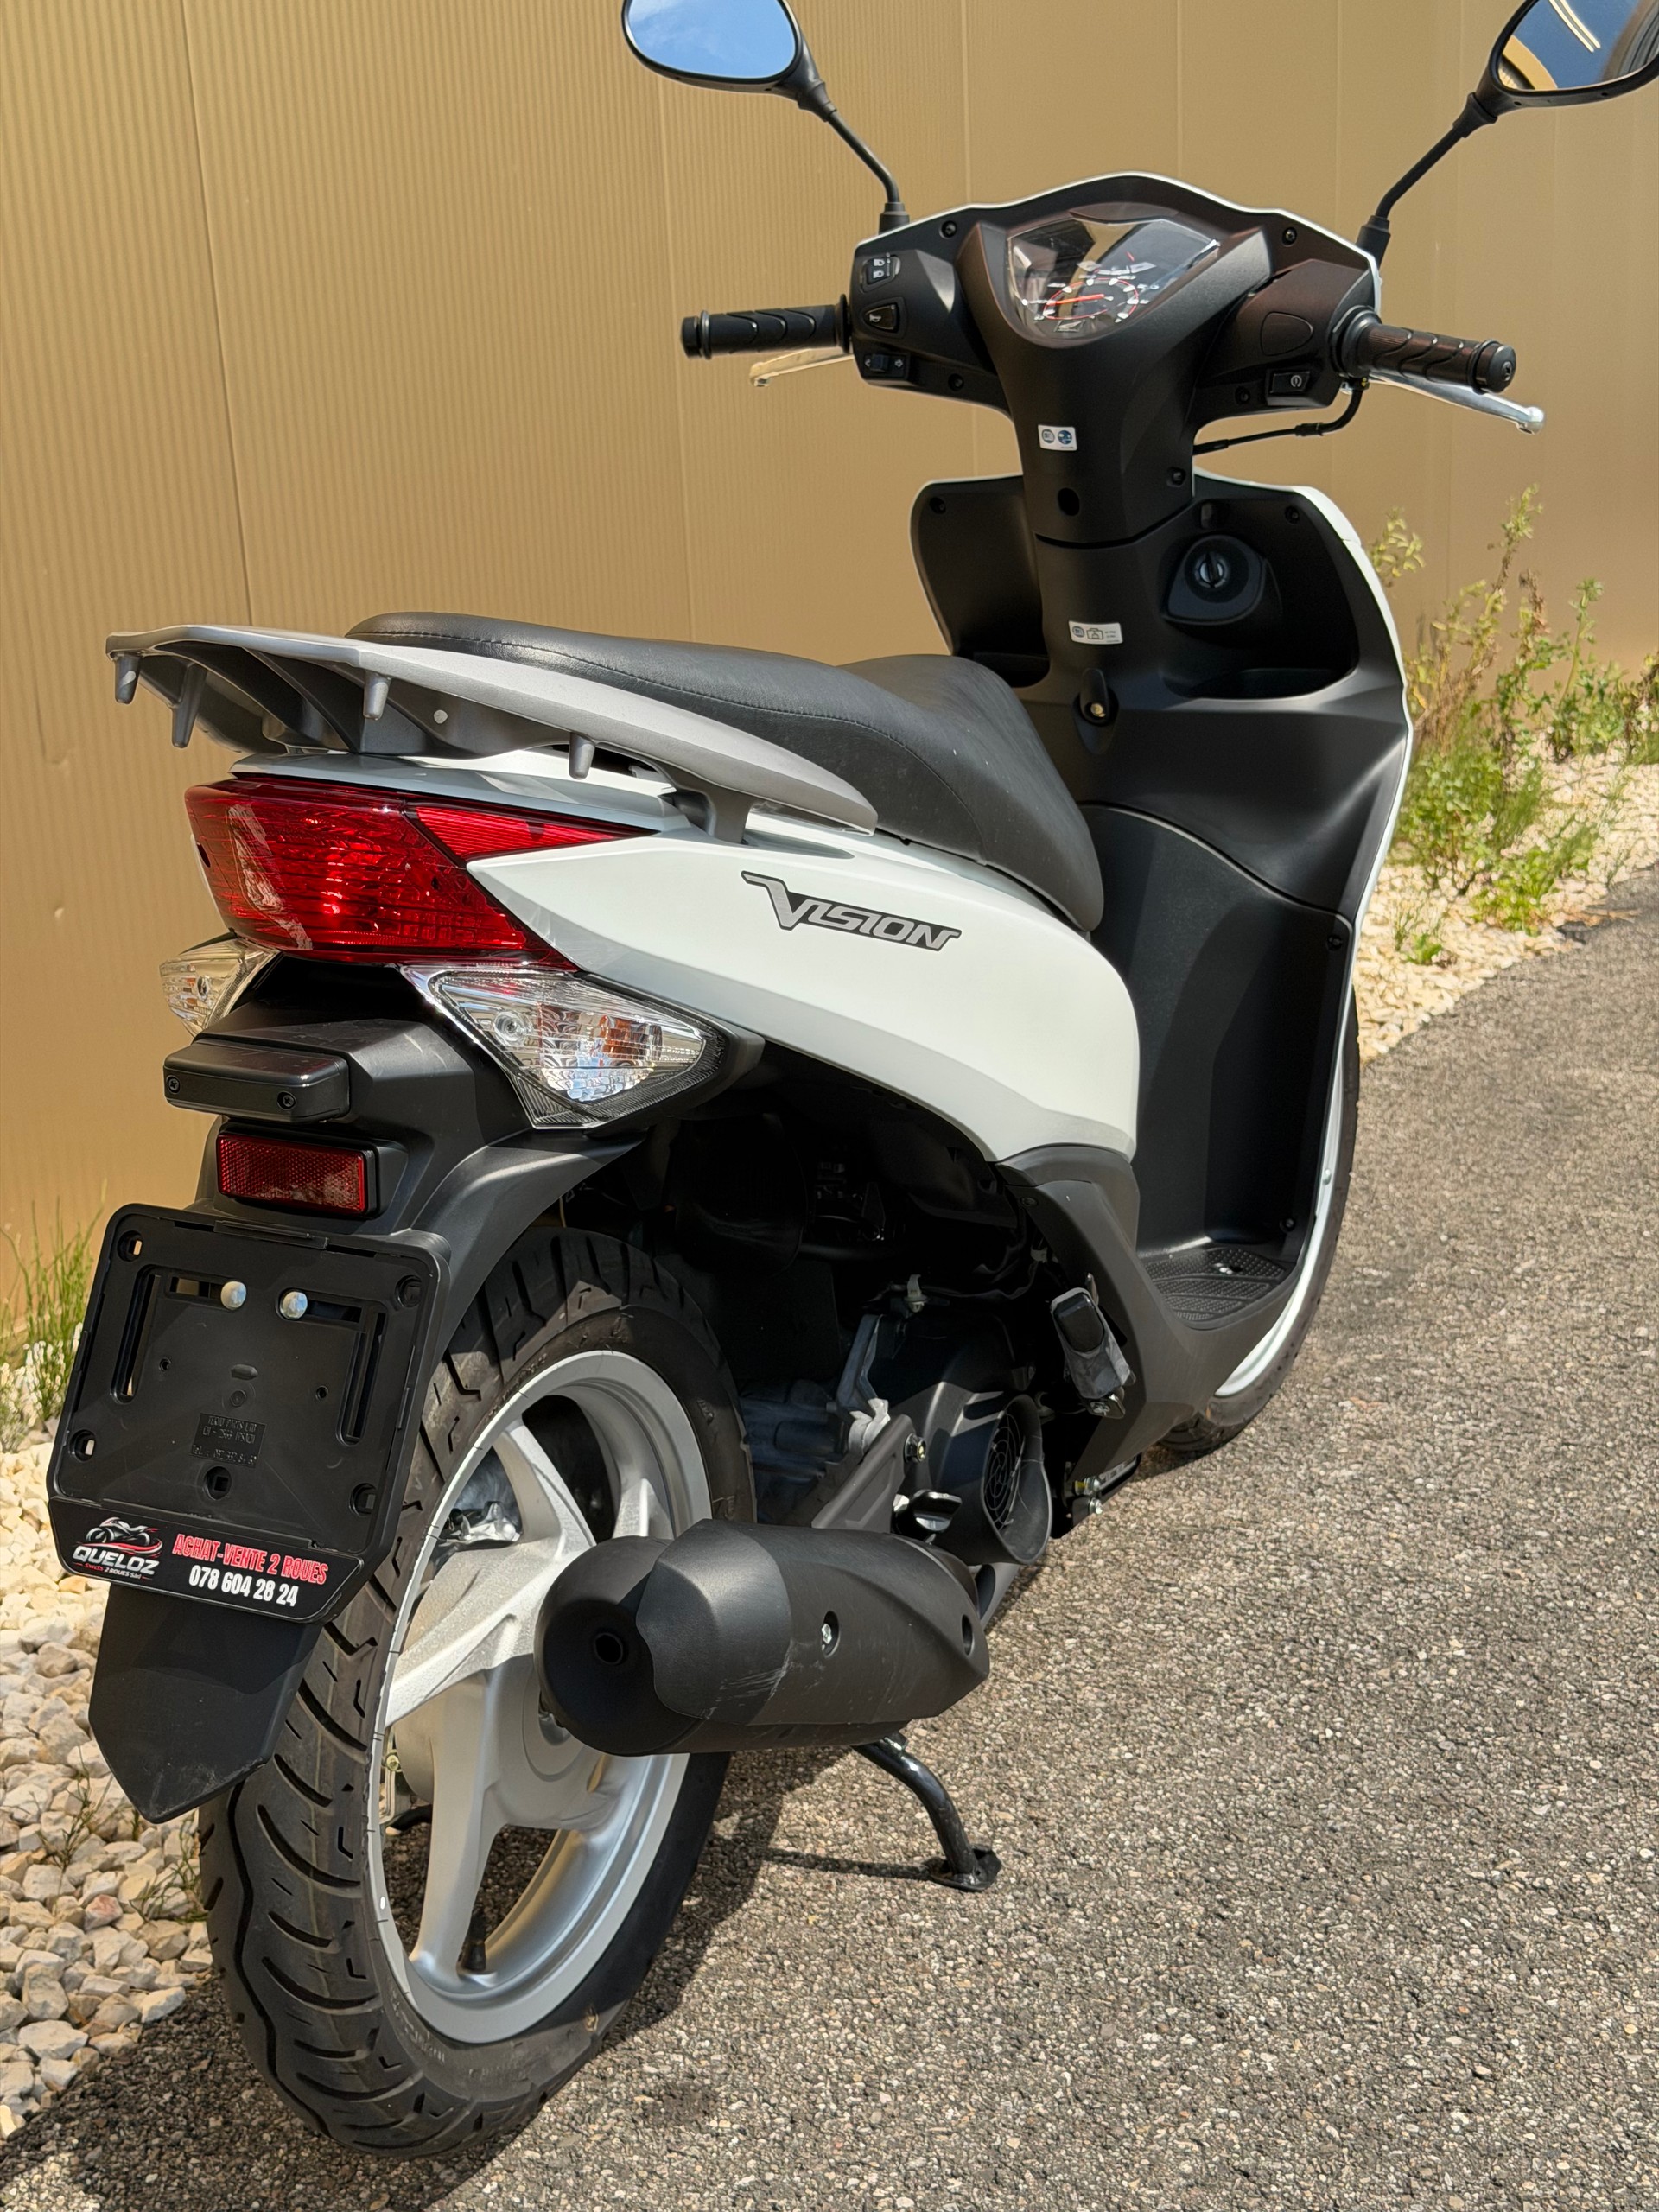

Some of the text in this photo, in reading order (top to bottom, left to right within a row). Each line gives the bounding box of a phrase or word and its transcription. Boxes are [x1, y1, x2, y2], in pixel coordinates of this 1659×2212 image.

[741, 870, 962, 951] VISION
[72, 1545, 160, 1575] QUELOZ
[172, 1534, 328, 1585] ACHAT-VENTE 2 ROUES
[188, 1565, 299, 1607] 078 604 28 24
